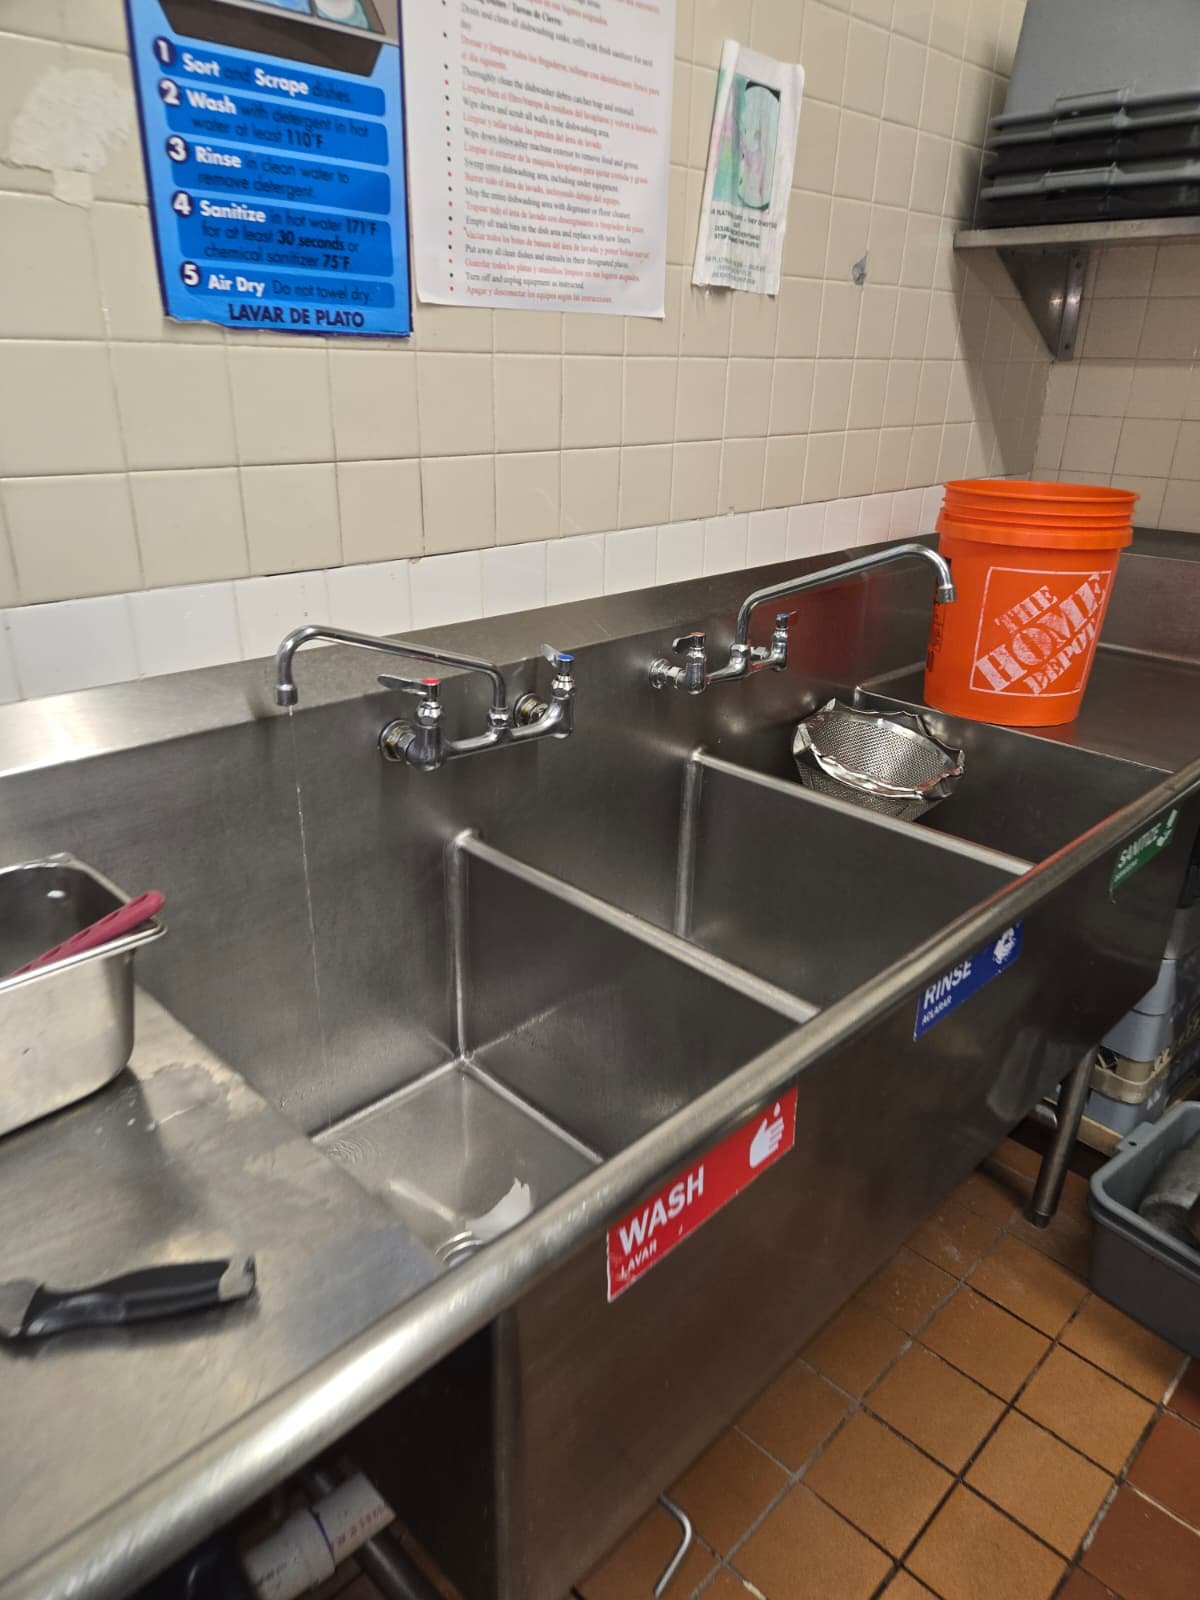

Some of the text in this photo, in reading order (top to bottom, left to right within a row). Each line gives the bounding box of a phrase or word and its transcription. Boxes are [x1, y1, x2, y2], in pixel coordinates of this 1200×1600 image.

[158, 40, 171, 62] 1
[181, 54, 220, 77] Sort
[254, 68, 309, 96] Scrape
[159, 81, 179, 105] 2
[185, 89, 237, 116] Wash
[240, 103, 268, 120] with
[272, 107, 331, 133] detergent
[350, 121, 368, 137] hot
[192, 118, 230, 134] water
[235, 122, 248, 136] at
[252, 125, 282, 142] least
[168, 138, 186, 161] 3
[195, 147, 241, 168] Rinse
[263, 159, 295, 177] clean
[301, 168, 334, 184] water
[197, 173, 249, 191] remove
[172, 194, 191, 215] 4
[200, 201, 266, 223] Sanitize
[310, 216, 342, 232] water
[204, 240, 263, 262] chemical
[267, 247, 318, 266] sanitizer
[277, 230, 294, 246] 30
[297, 233, 344, 251] seconds
[184, 264, 199, 287] 5
[208, 275, 232, 292] Air
[236, 275, 265, 297] Dry
[272, 280, 290, 296] Do
[229, 305, 364, 328] LAVAR DE PLATO
[975, 572, 1106, 693] HOME
[994, 585, 1058, 634] THE
[1023, 618, 1097, 695] DEPOT
[924, 960, 971, 1010] RINSE
[619, 1163, 704, 1256] WASH
